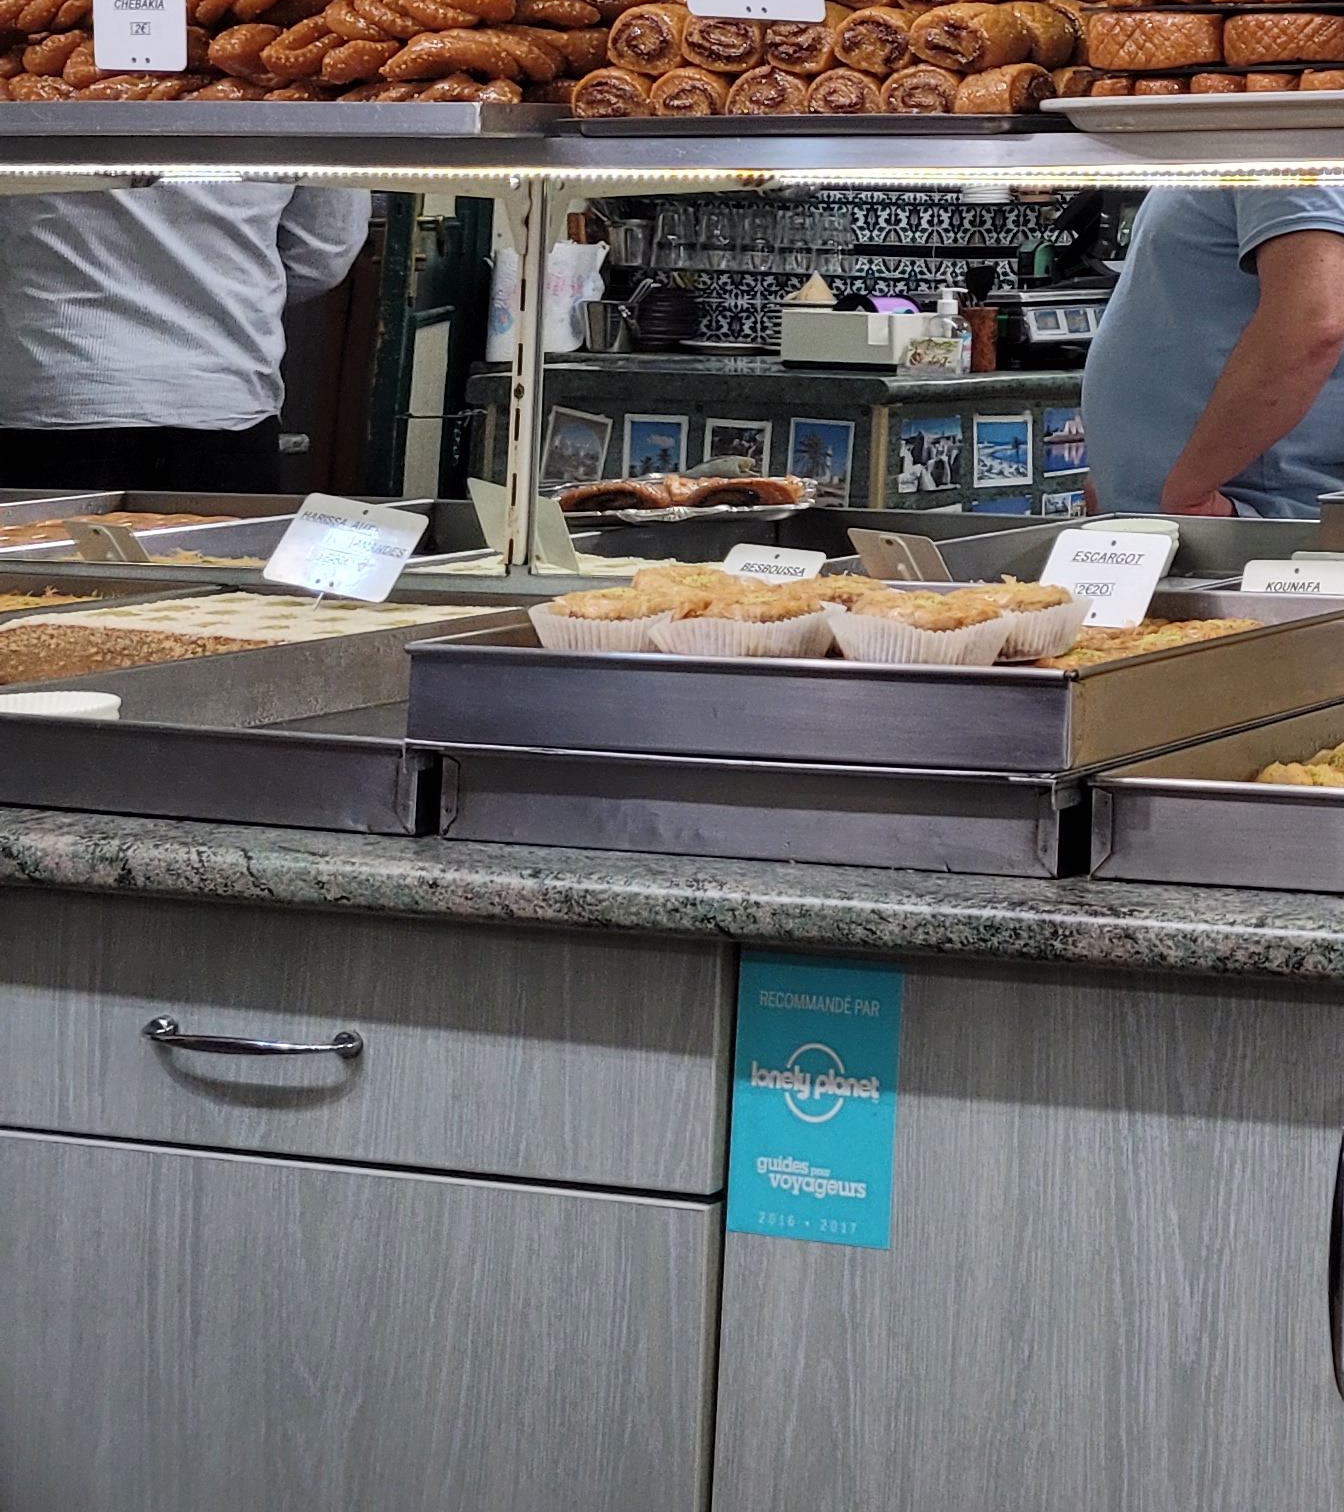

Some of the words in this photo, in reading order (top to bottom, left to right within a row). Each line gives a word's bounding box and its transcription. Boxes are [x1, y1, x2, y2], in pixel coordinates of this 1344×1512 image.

[113, 0, 165, 9] CHEBAKIA
[134, 22, 148, 34] 2€
[301, 510, 348, 527] HARISSA
[1071, 550, 1145, 565] ESCARGOT
[740, 562, 806, 577] BESBOUSSA
[1265, 581, 1321, 593] KOUNAFA
[854, 998, 880, 1018] PAR
[751, 1060, 812, 1101] lonely
[814, 1068, 880, 1102] planet
[756, 1155, 810, 1175] guides
[810, 1165, 832, 1178] pour
[769, 1171, 868, 1200] voyageurs
[820, 1218, 858, 1235] 2017
